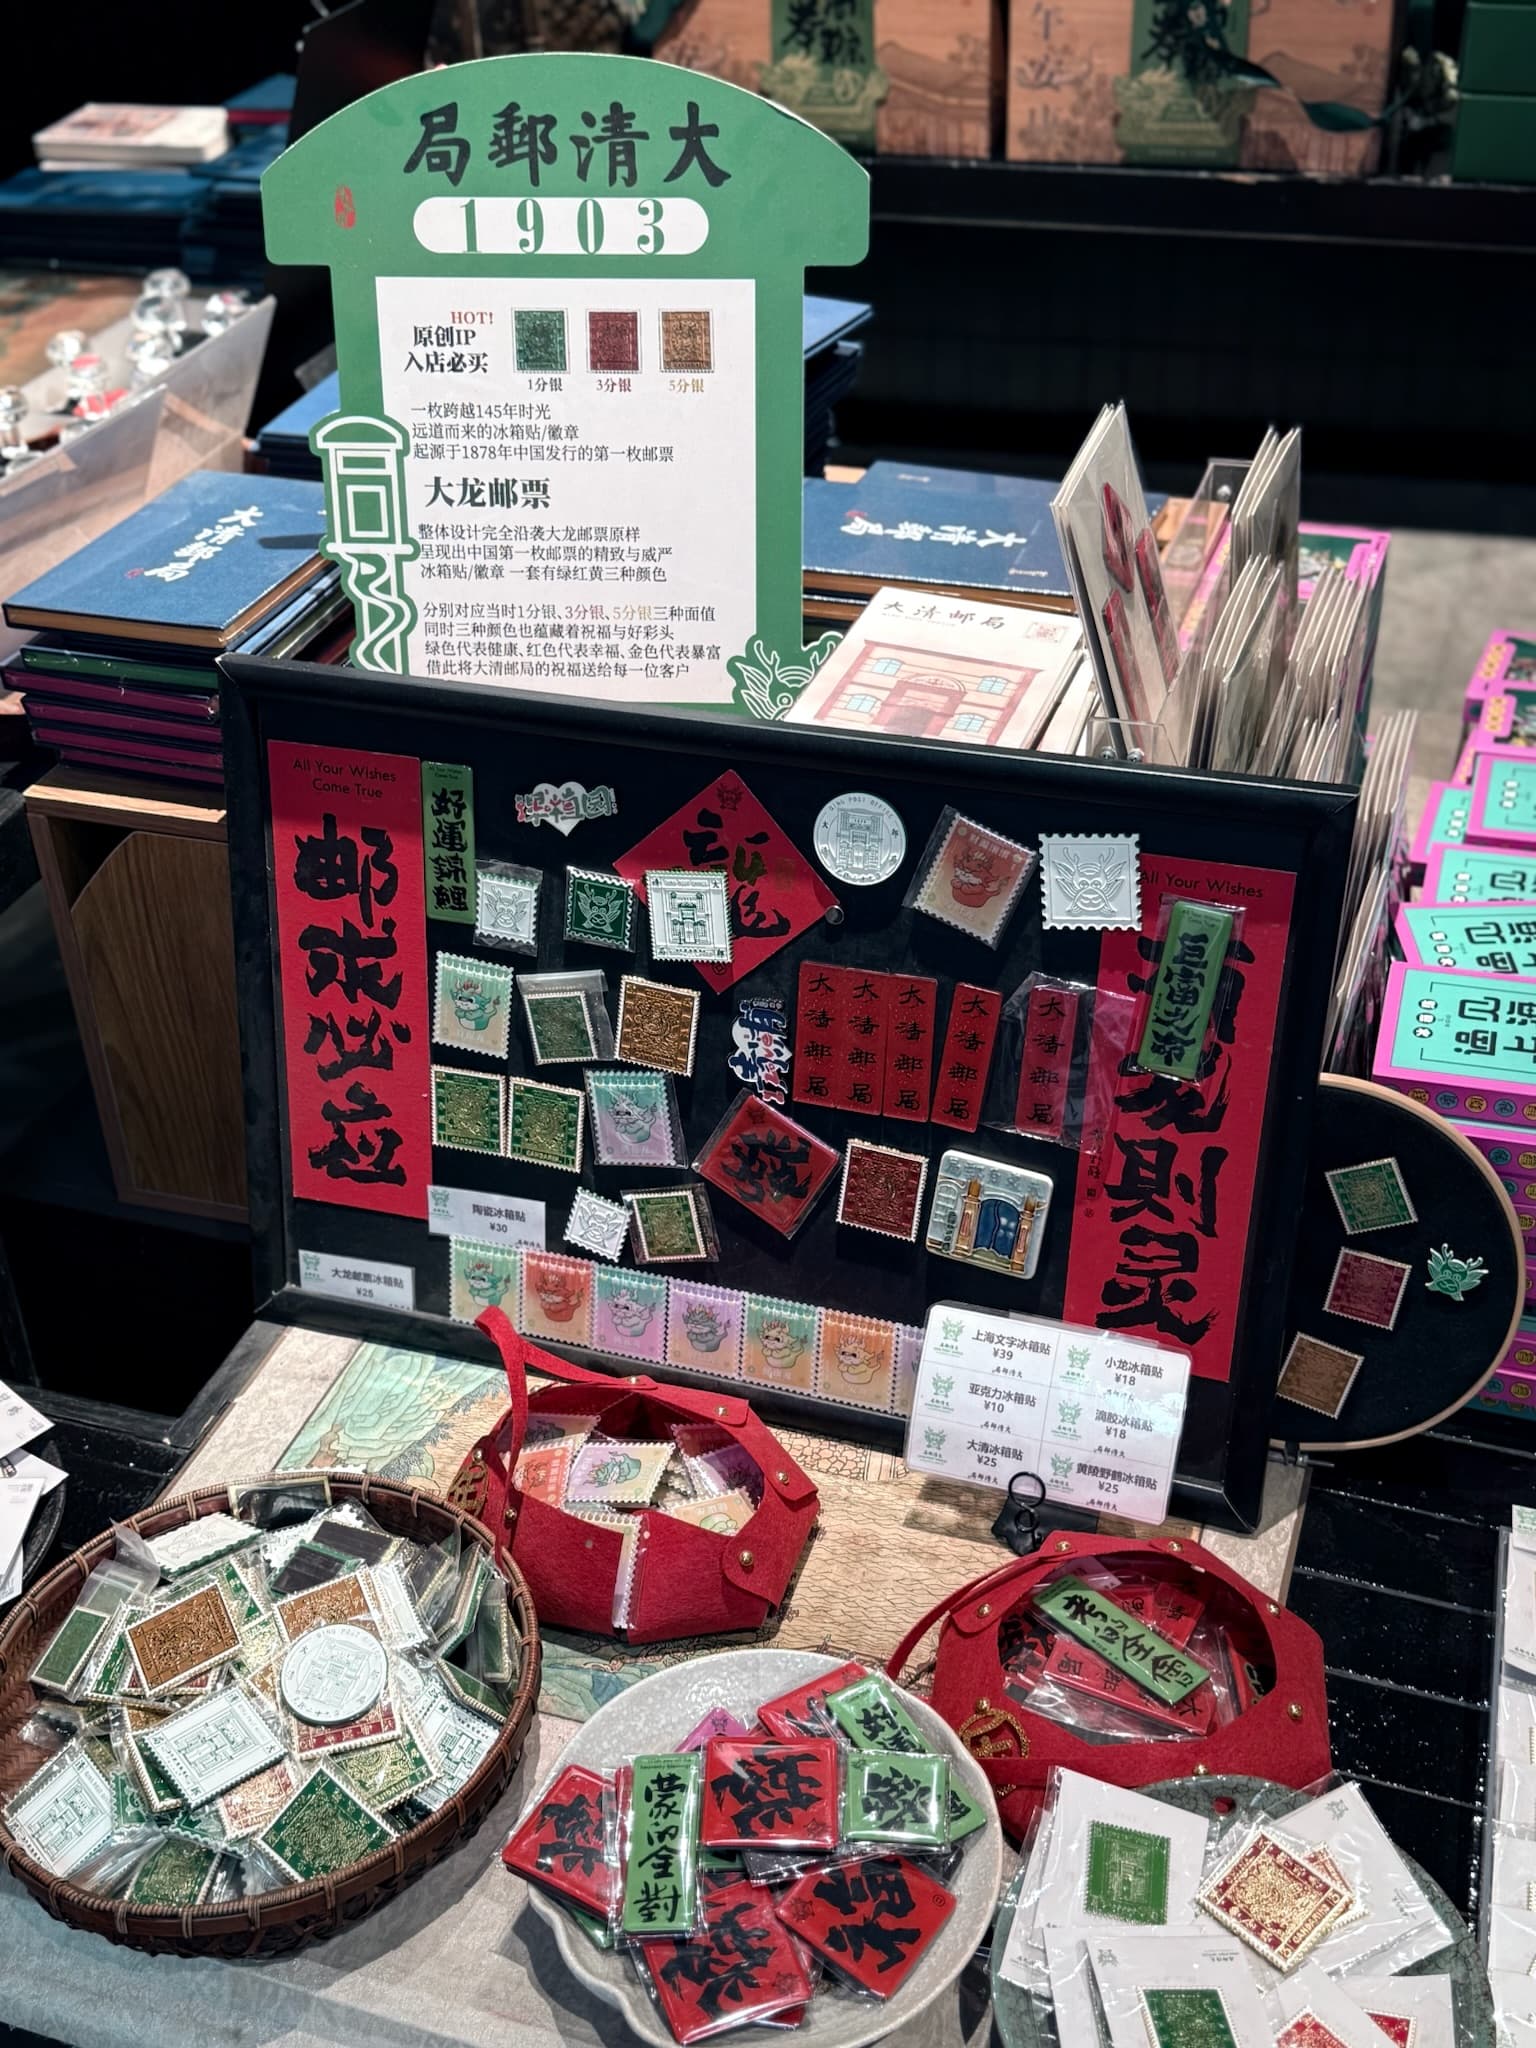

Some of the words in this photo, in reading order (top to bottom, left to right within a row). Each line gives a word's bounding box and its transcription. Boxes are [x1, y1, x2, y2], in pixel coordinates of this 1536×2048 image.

[459, 198, 667, 254] 1903
[450, 311, 494, 325] HOT!
[413, 326, 476, 348] 原创IP
[404, 351, 489, 374] 入店必买
[527, 379, 563, 392] 1分银
[596, 379, 632, 393] 3分银
[669, 379, 705, 394] 5分银
[410, 402, 552, 420] 一枚跨越145年时光
[411, 423, 579, 441] 远道而来的冰箱贴/徽章
[413, 443, 675, 463] 起源于1878年中国发行的第一枚邮票
[424, 476, 551, 510] 大龙邮票
[418, 524, 641, 542] 整体设计完全沿袭大龙邮票原样
[420, 544, 673, 563] 呈现出中国第一枚邮票的精致与威严
[420, 564, 505, 581] 冰箱贴/徽章
[509, 565, 668, 583] 一套有绿红黄三种颜色
[423, 603, 716, 622] 分别对应当时1分银、3分银、5分银三种面值
[424, 622, 675, 641] 同时三种颜色也蕴藏着祝福与好彩头
[425, 642, 721, 661] 绿色代表健康、红色代表幸福、金色代表暴富
[427, 661, 690, 679] 借此将大清邮局的祝福送给每一位客户
[293, 759, 311, 773] All
[315, 762, 343, 776] Your
[350, 766, 397, 782] Wishes
[312, 778, 350, 794] Come
[355, 784, 383, 799] True
[1166, 874, 1200, 890] Your
[1207, 879, 1264, 898] Wishes
[293, 812, 412, 1187] 邮求必应
[471, 1203, 527, 1222] 陶瓷冰箱贴
[489, 1222, 508, 1233] ¥30
[330, 1267, 405, 1288] 大龙邮票冰箱贴
[971, 1329, 1052, 1356] 上海文字冰箱贴
[993, 1347, 1014, 1360] ¥39
[1104, 1357, 1164, 1379] 小龙冰箱贴
[1115, 1373, 1136, 1386] ¥18
[968, 1382, 1037, 1407] 亚克力冰箱贴
[983, 1400, 1005, 1413] ¥10
[1105, 1427, 1127, 1440] ¥18
[966, 1439, 1024, 1462] 大清冰箱贴
[976, 1454, 998, 1467] ¥25
[1098, 1481, 1119, 1494] ¥25
